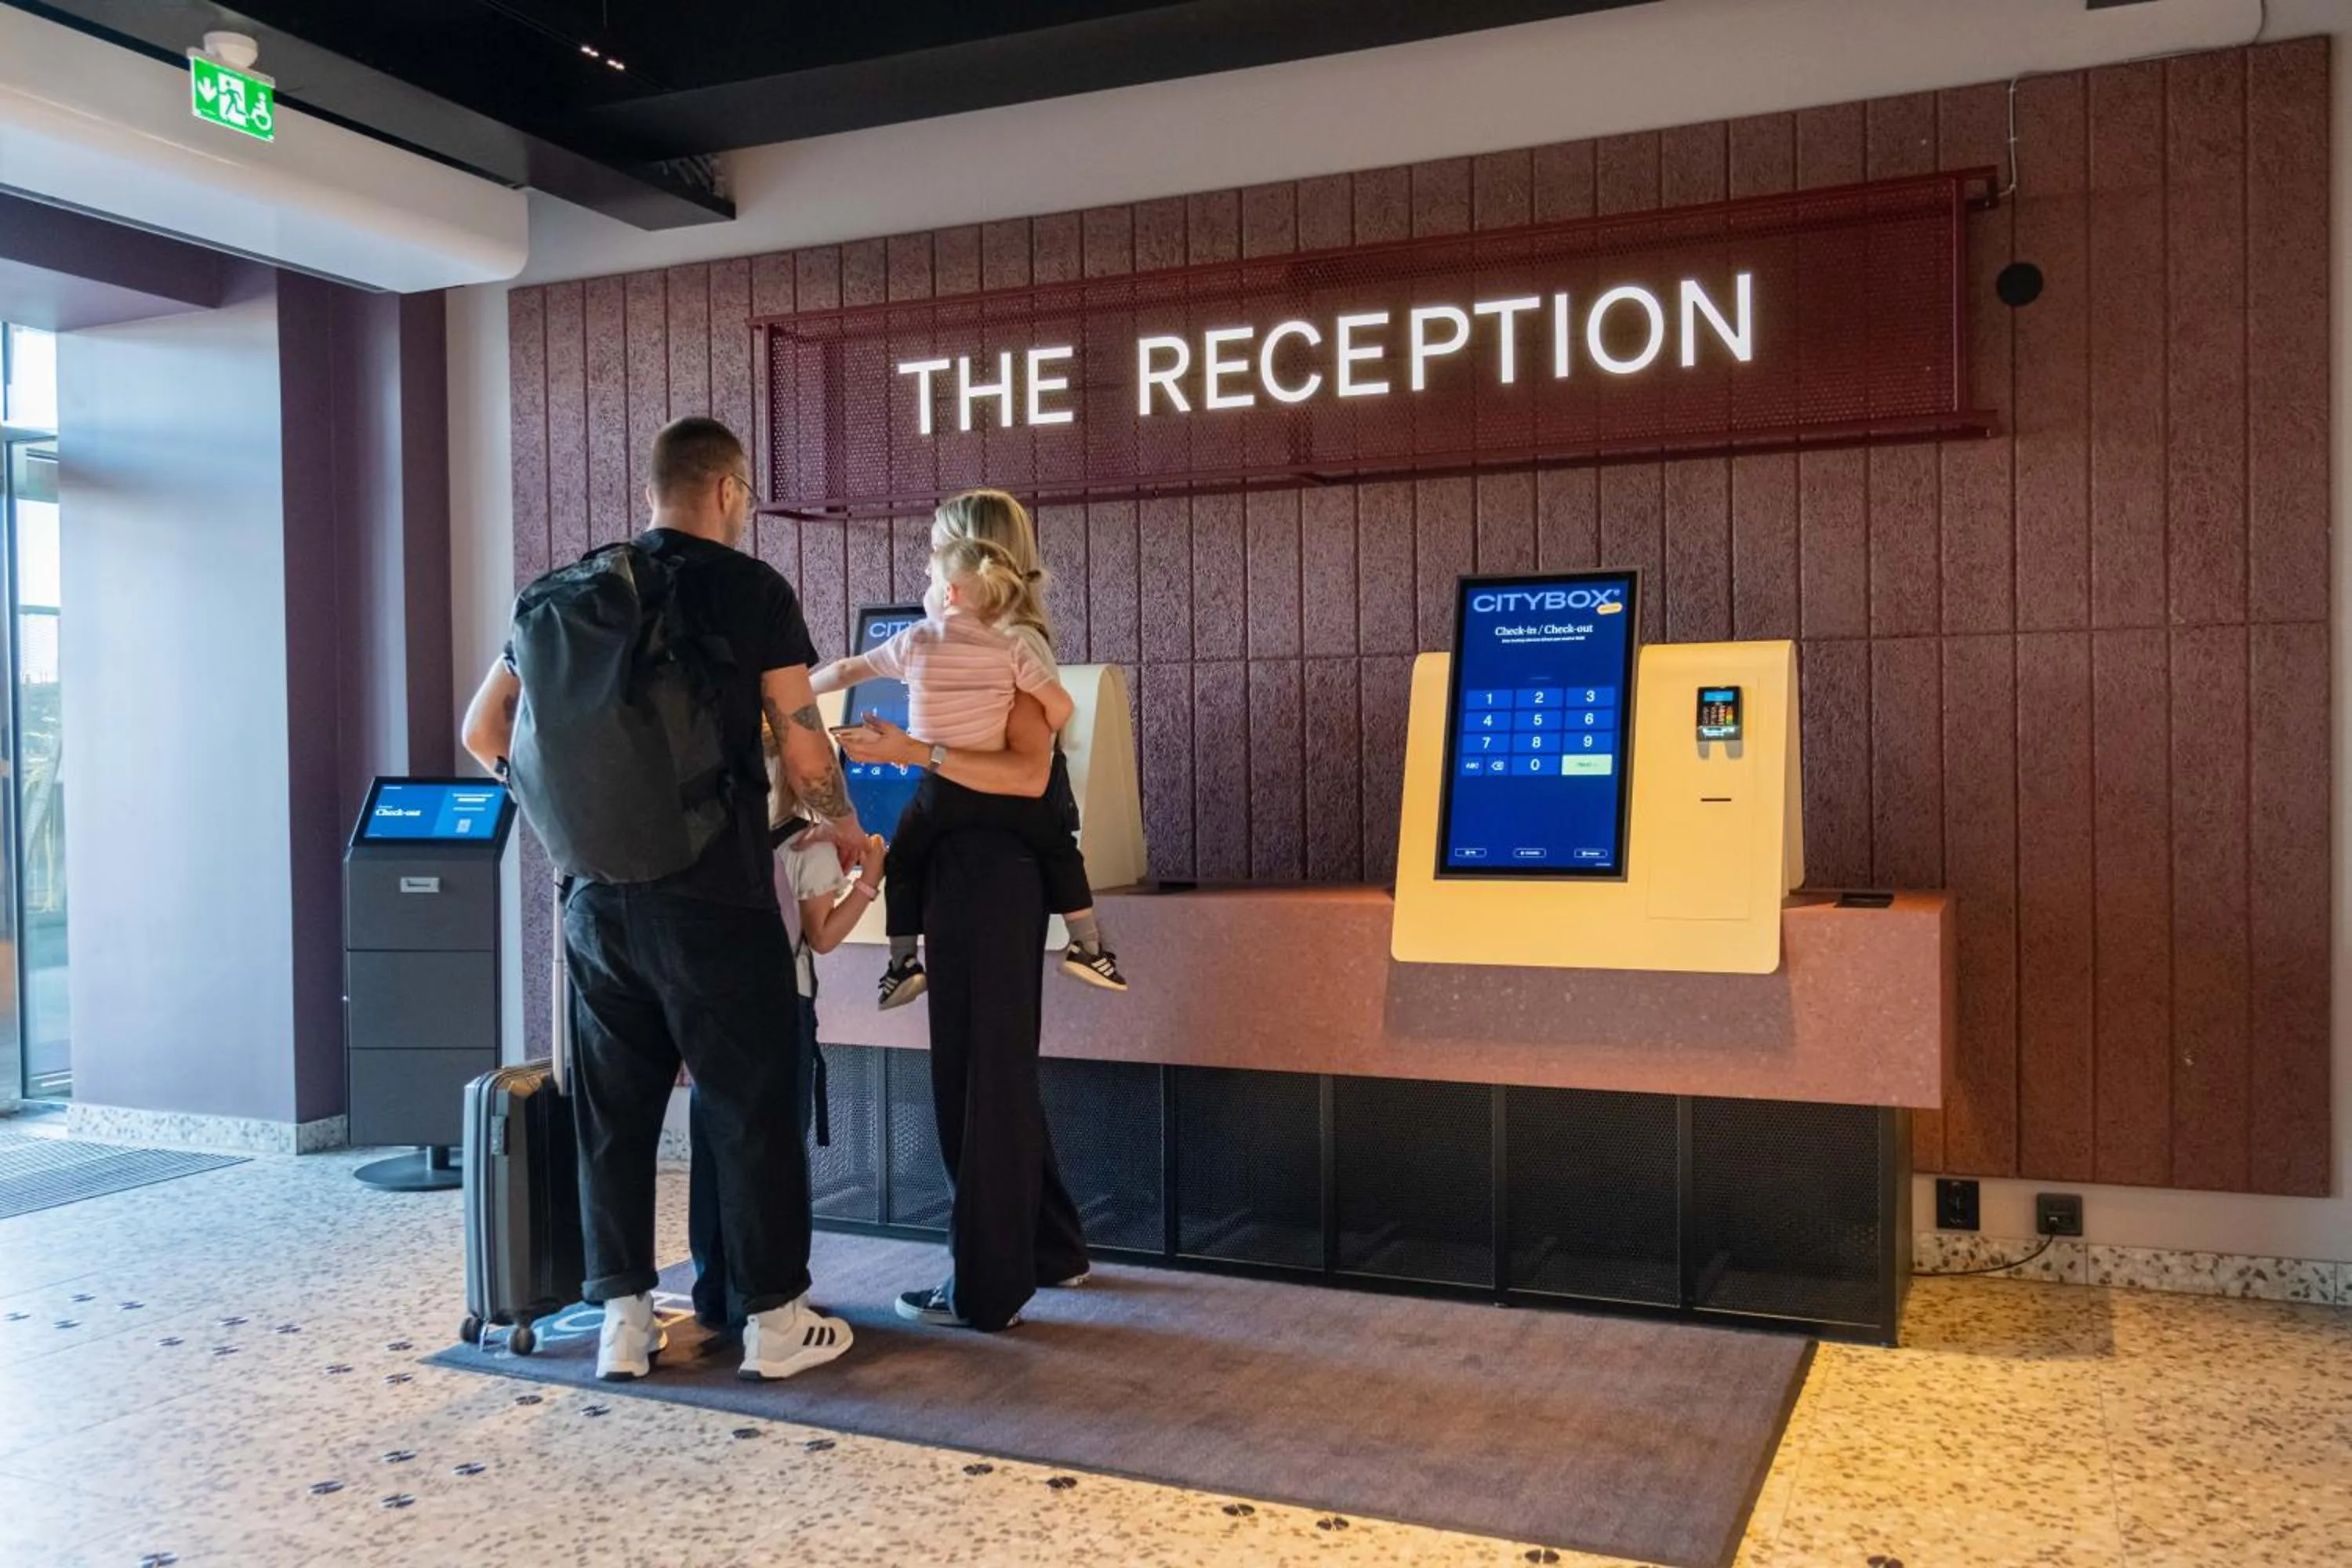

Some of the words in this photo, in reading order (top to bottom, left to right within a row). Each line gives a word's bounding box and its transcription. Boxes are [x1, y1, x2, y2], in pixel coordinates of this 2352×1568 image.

[898, 346, 1074, 435] THE
[1138, 274, 1752, 416] RECEPTION
[1472, 589, 1615, 613] CITYBOX
[1494, 625, 1537, 637] Check-in
[1544, 622, 1594, 635] Check-out
[1486, 692, 1493, 705] 1
[1534, 691, 1544, 703] 2
[1586, 689, 1595, 702] 3
[1483, 714, 1493, 727] 4
[1534, 713, 1543, 726] 5
[1584, 713, 1595, 725] 6
[1483, 736, 1491, 749] 7
[1532, 735, 1541, 749] 8
[1583, 735, 1593, 747] 9
[1530, 758, 1541, 771] 0
[375, 808, 422, 817] Check-out
